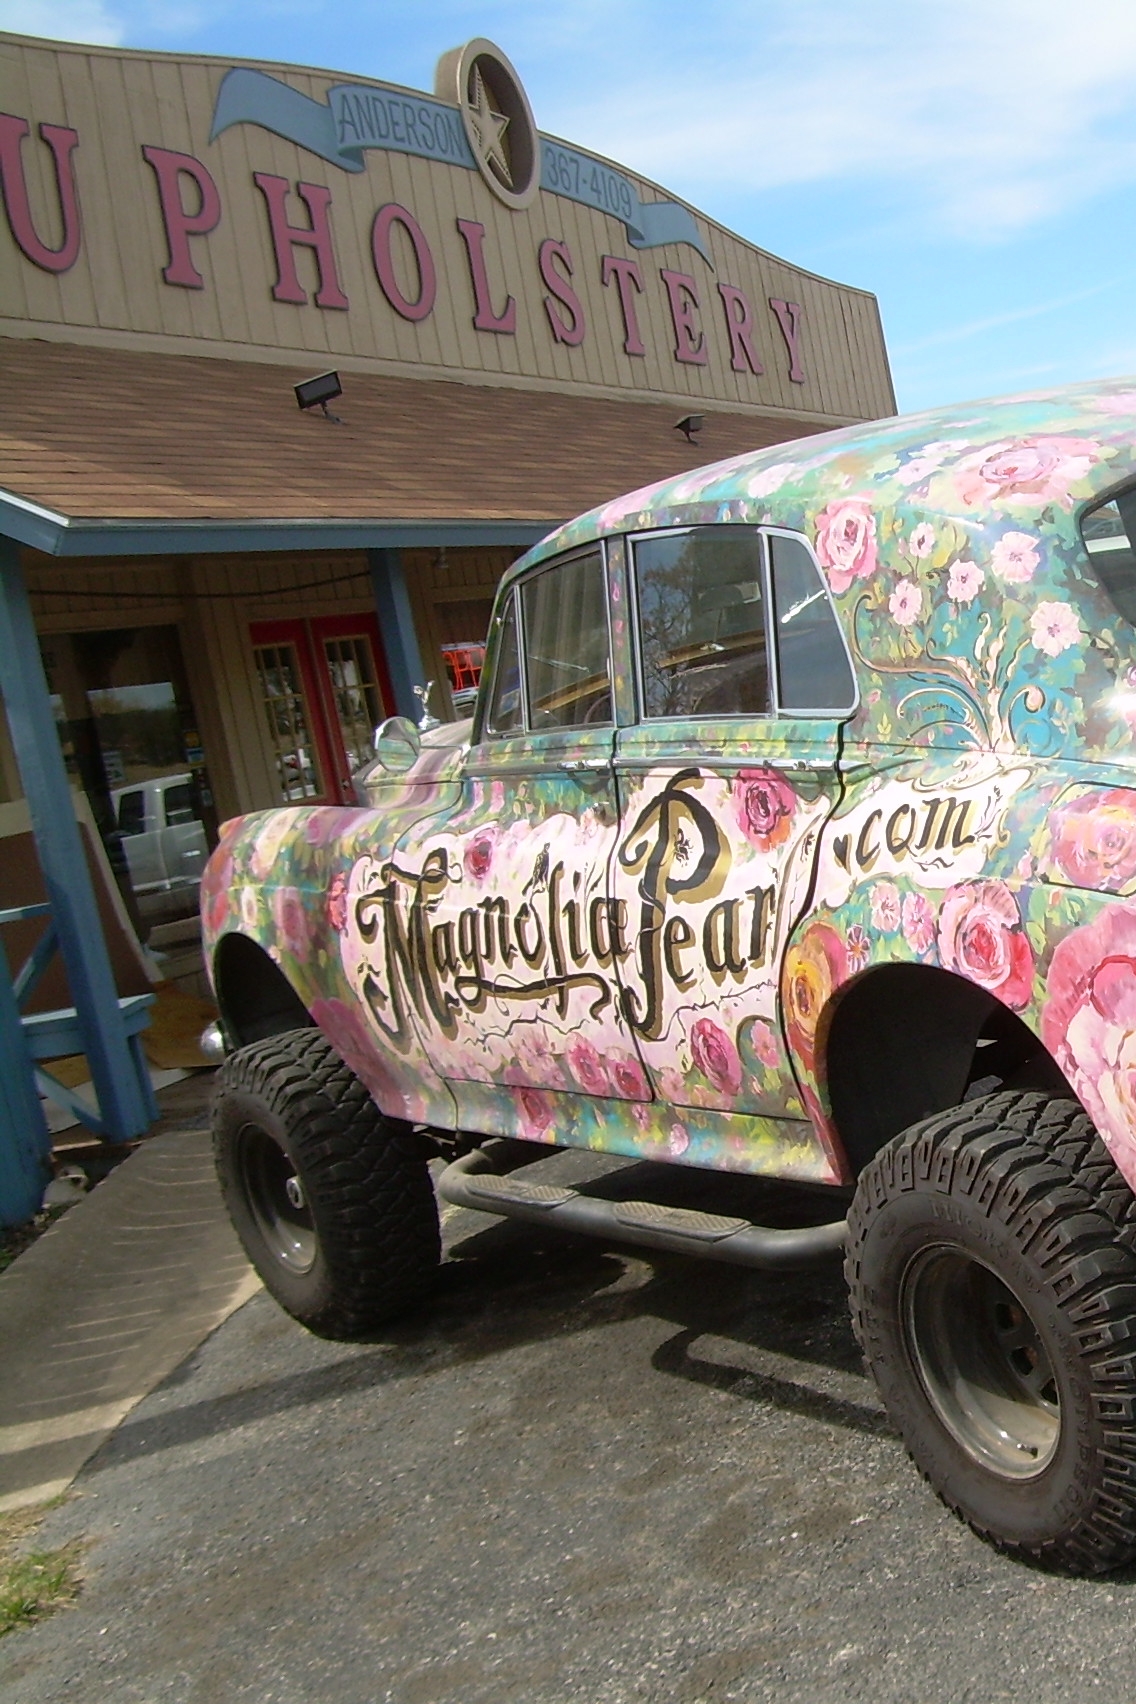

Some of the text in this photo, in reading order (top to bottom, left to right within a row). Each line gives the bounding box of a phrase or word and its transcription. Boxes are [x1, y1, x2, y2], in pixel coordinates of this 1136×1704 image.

[0, 111, 805, 384] UPHOLSTERY
[338, 94, 633, 219] ANDERSON 367-4109
[355, 847, 630, 1047] Magnolia
